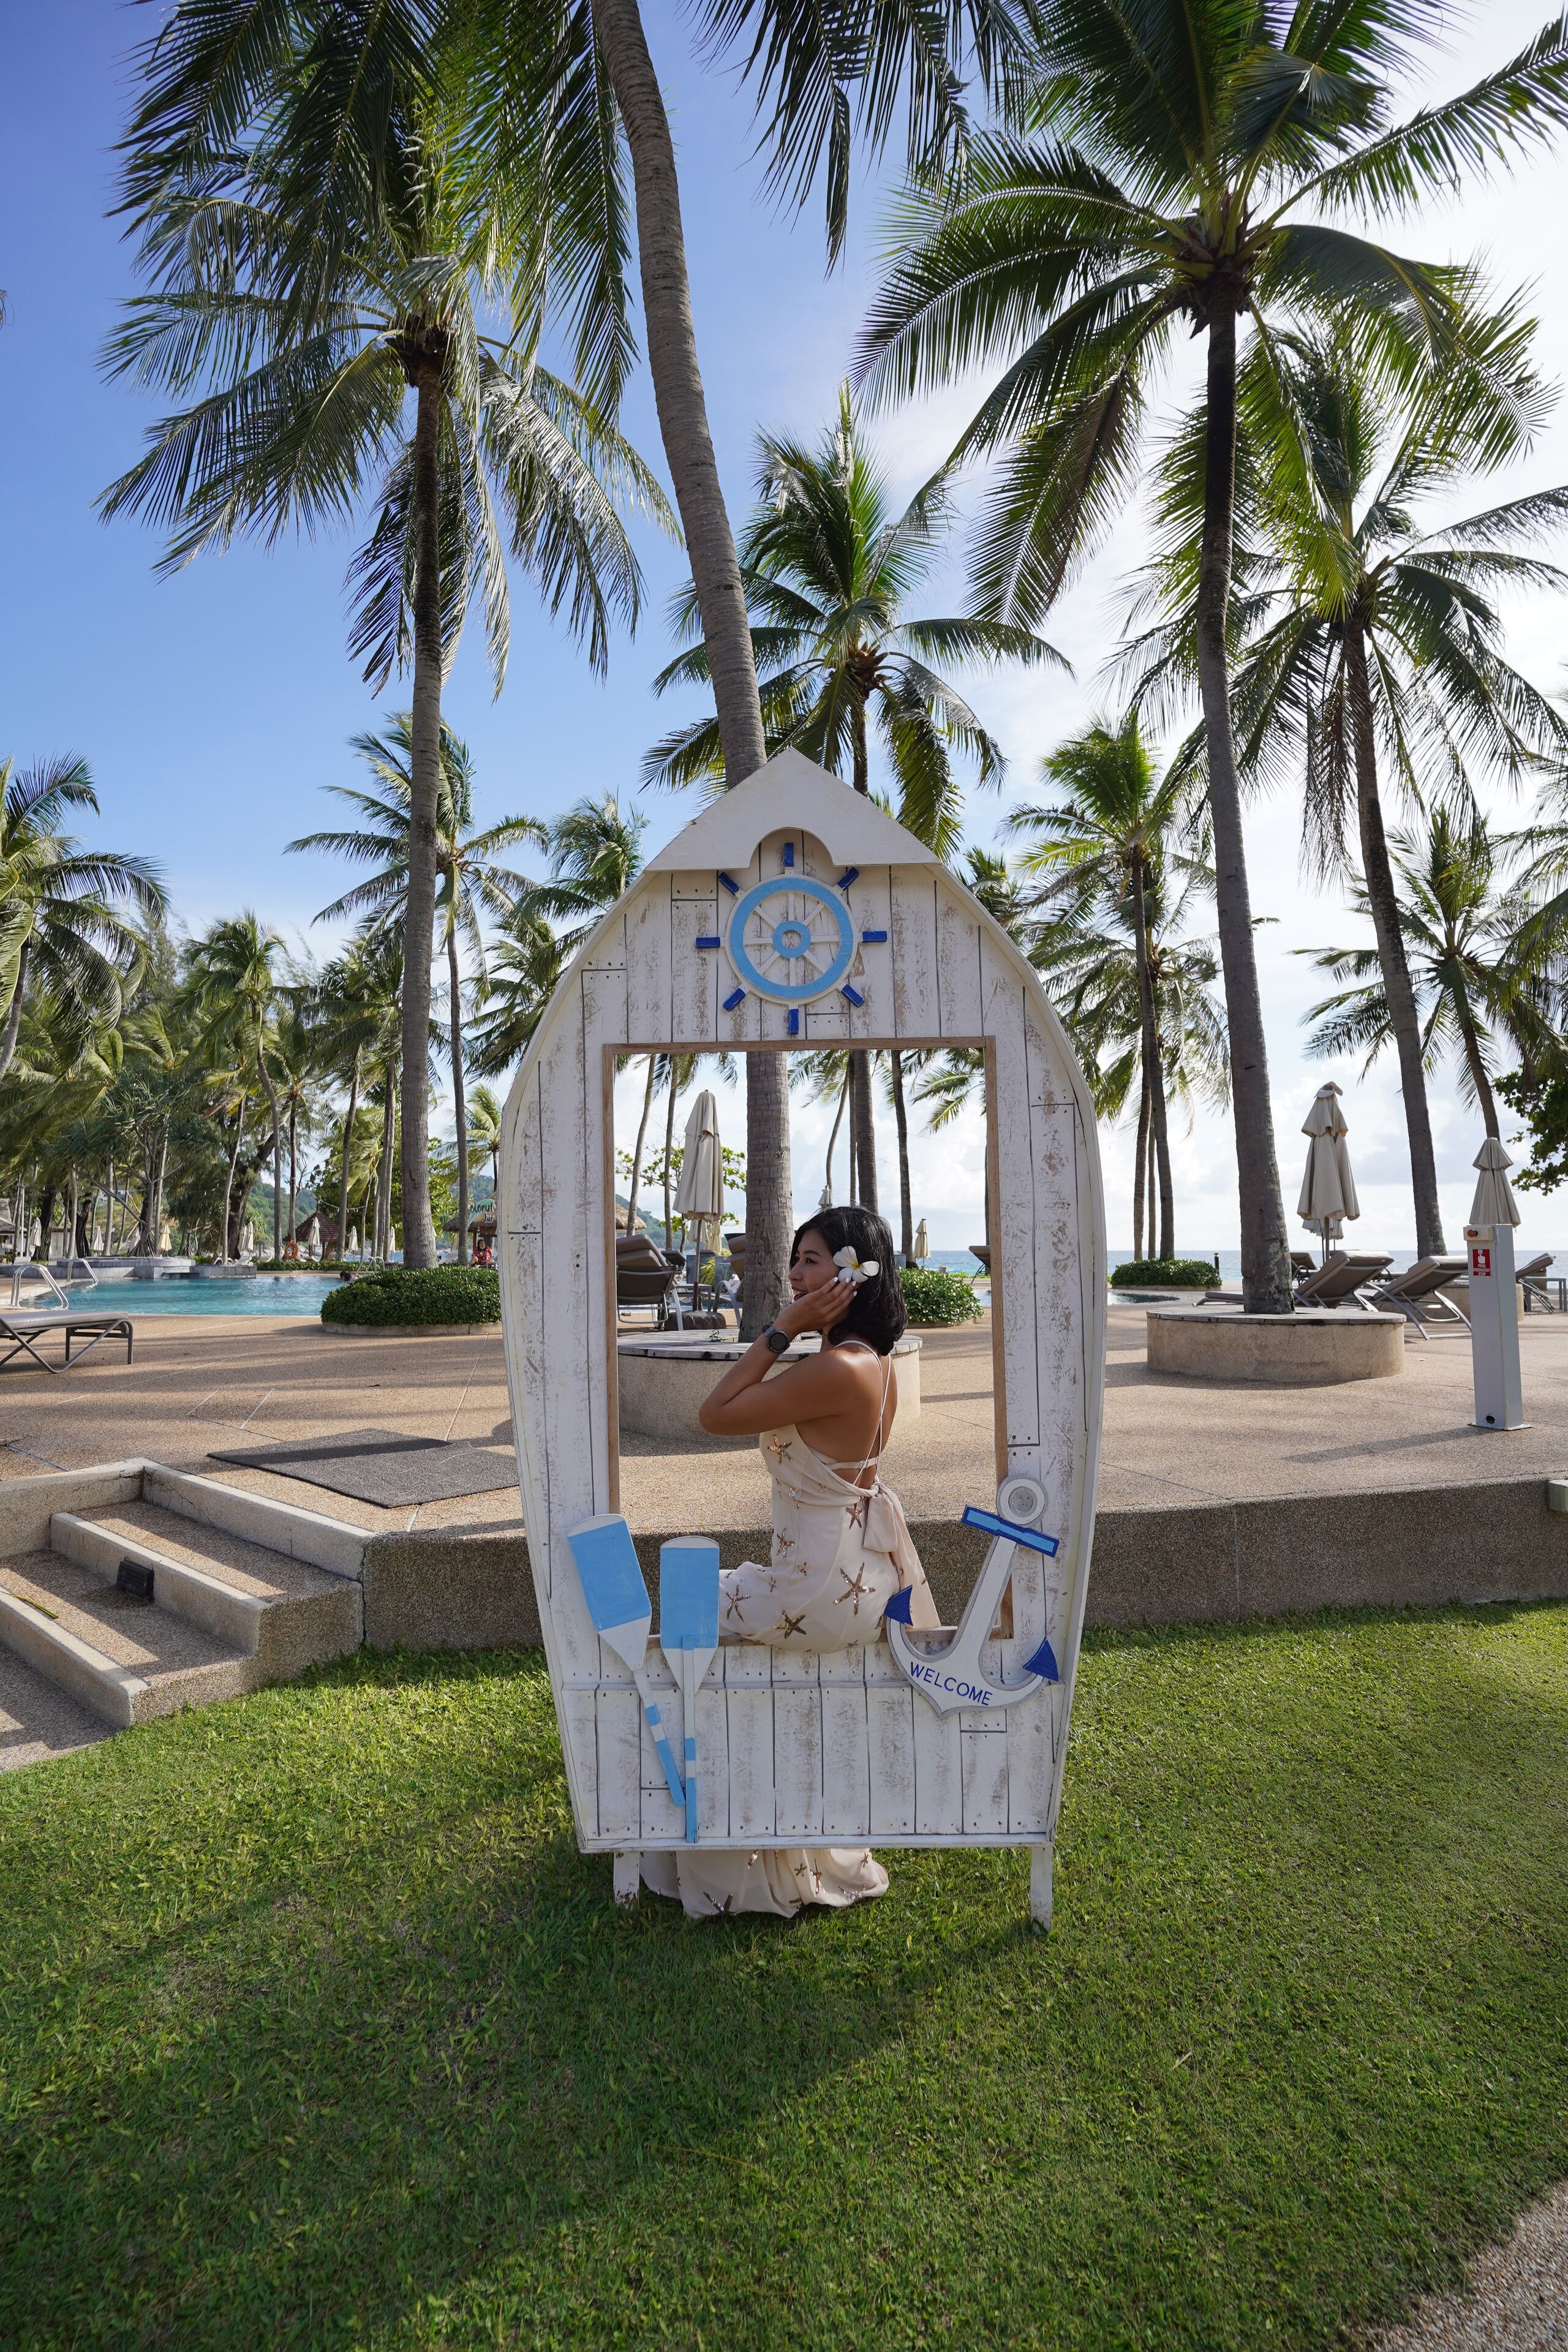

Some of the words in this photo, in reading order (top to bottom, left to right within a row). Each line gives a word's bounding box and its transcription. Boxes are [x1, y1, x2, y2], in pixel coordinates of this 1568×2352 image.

[467, 1202, 494, 1213] oconut
[484, 1213, 494, 1223] bar
[910, 1661, 993, 1706] WELCOME
